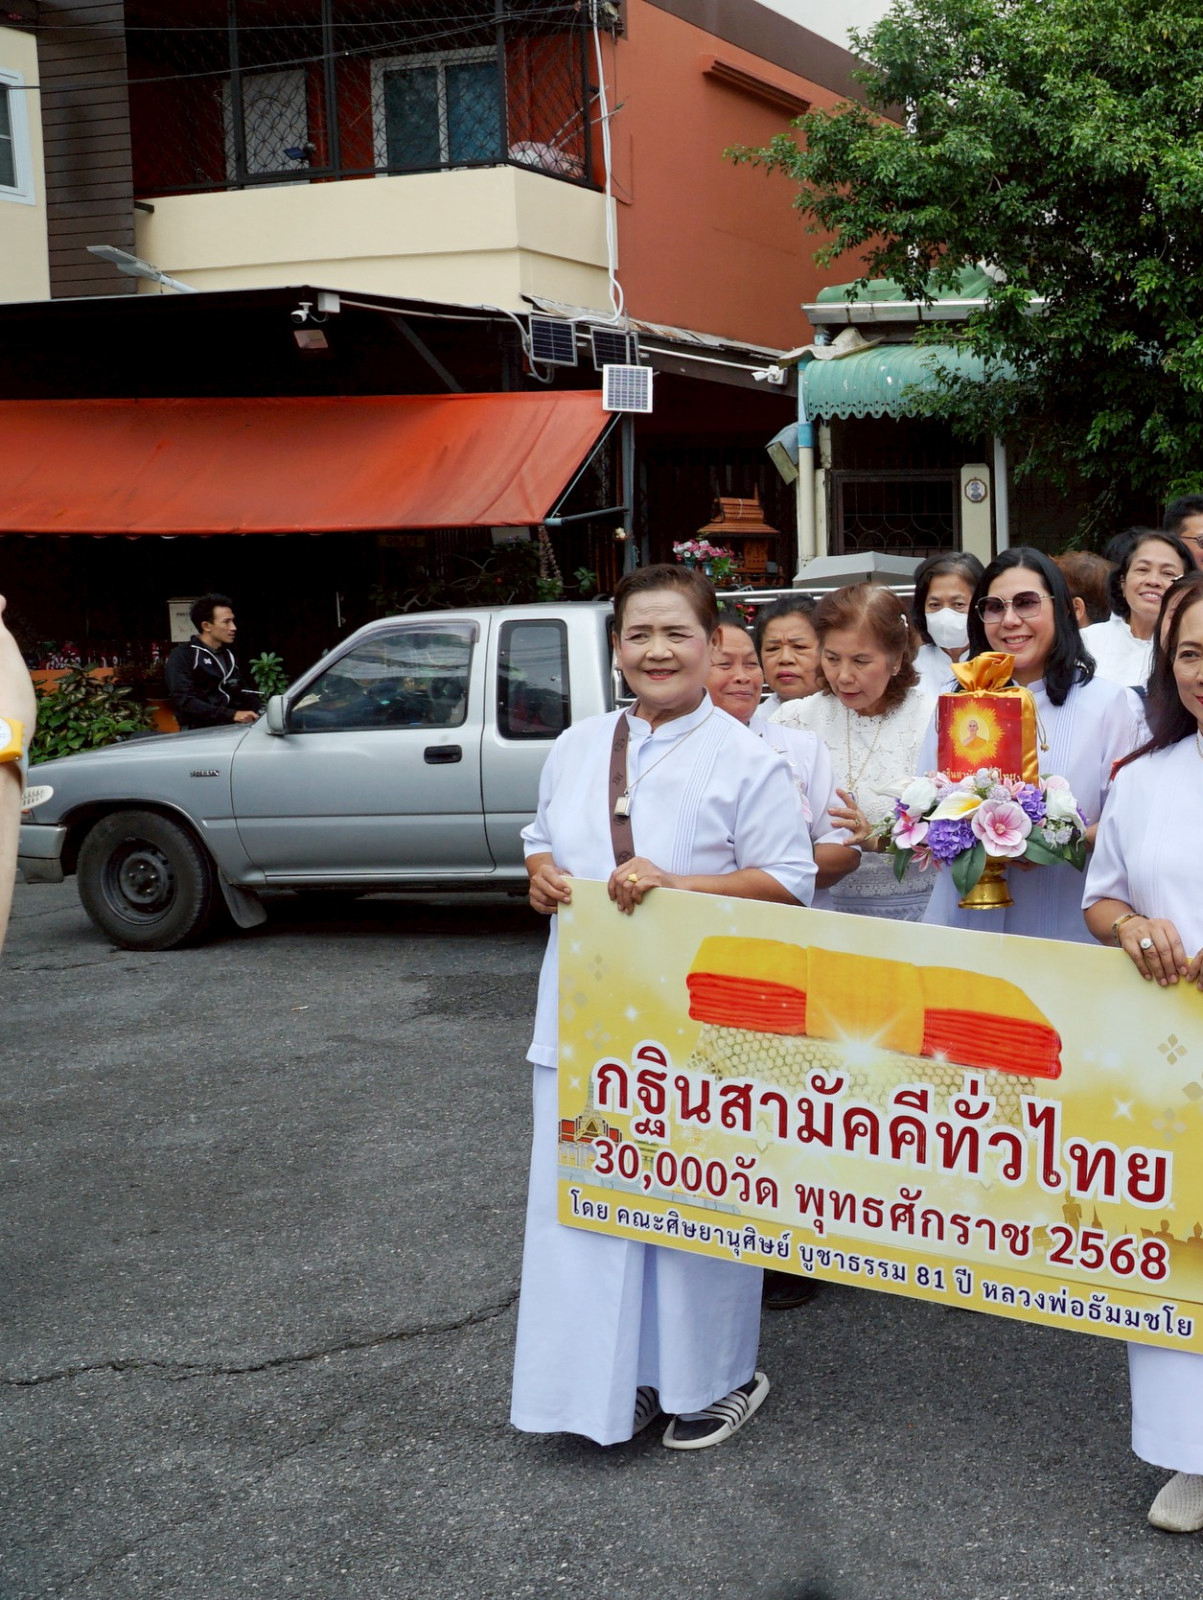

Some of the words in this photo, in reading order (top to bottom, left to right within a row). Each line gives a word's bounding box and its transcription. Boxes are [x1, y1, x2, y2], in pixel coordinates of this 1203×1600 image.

[596, 1045, 1167, 1204] กฐินสามัคคีทั่วไทย
[570, 1189, 609, 1220] โดย
[617, 1208, 791, 1258] คณะศิษยานุศิษย์
[799, 1245, 906, 1281] บูชาธรรม
[916, 1266, 945, 1289] 81
[956, 1268, 972, 1294] ปี
[983, 1281, 1193, 1337] หลวงพ่อธัมมชโย
[594, 1139, 779, 1208] 30,000วัด
[794, 1186, 1031, 1257] พุทธศักราช
[1049, 1226, 1167, 1281] 2568
